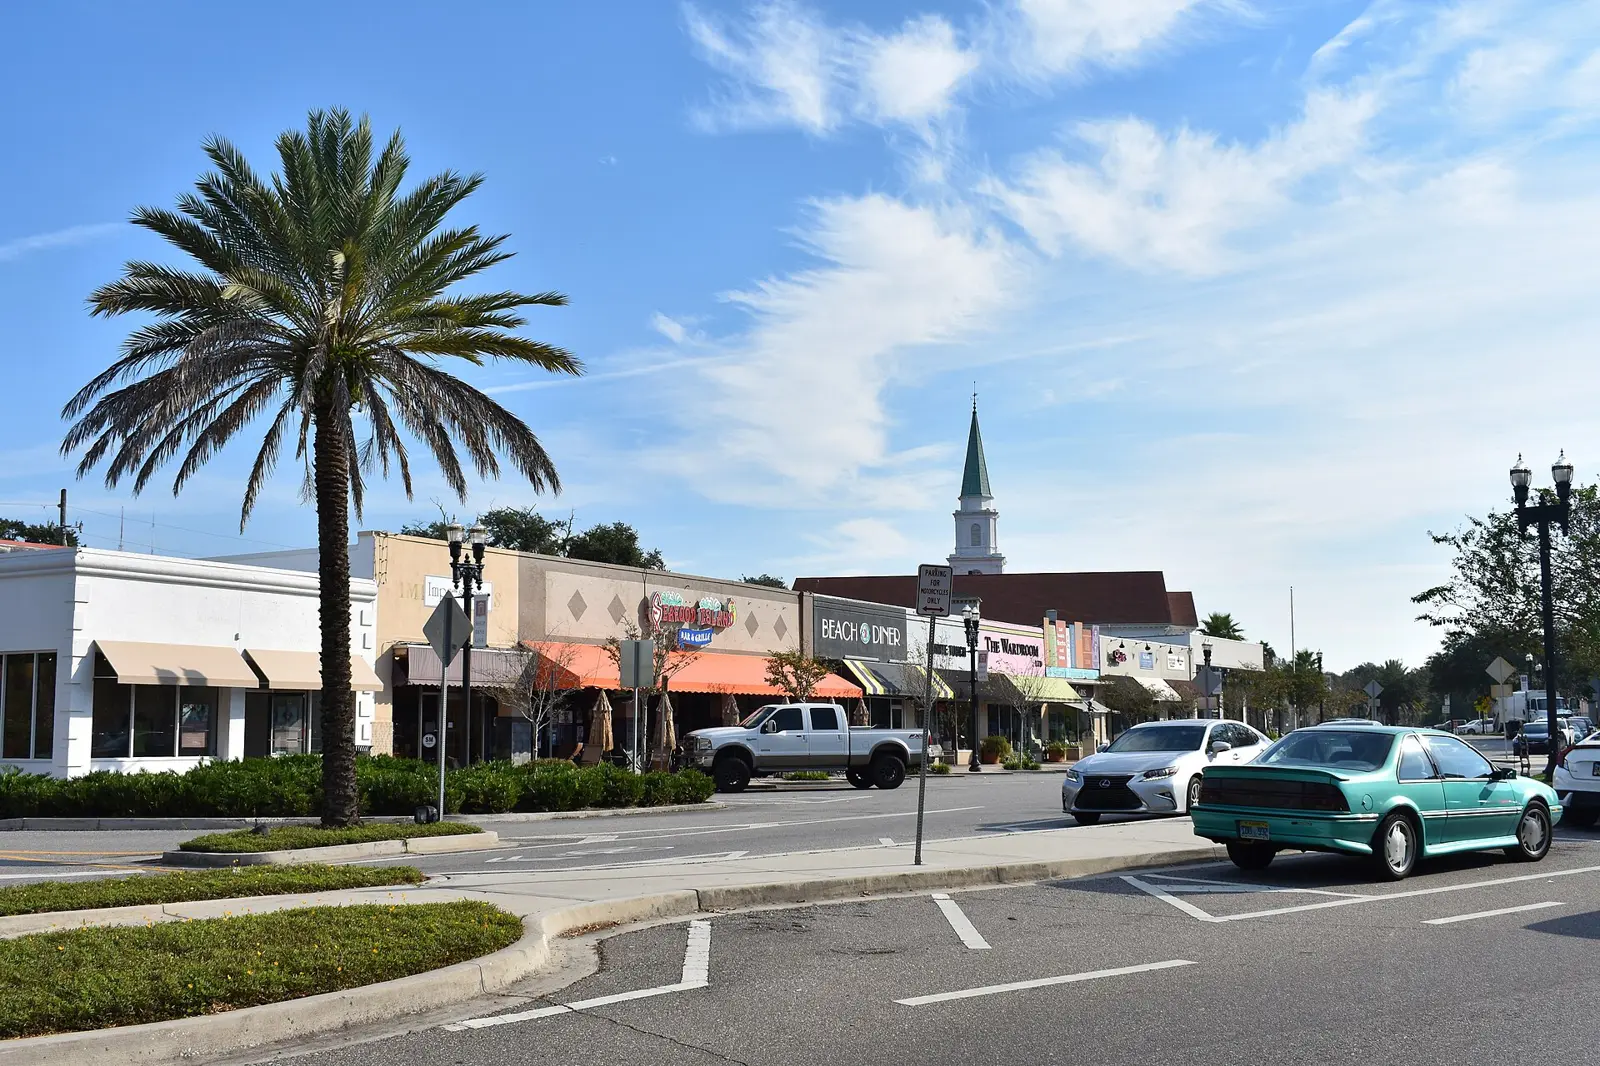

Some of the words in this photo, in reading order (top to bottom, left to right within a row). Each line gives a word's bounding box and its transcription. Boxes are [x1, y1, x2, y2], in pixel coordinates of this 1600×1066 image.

[925, 569, 947, 578] PARKING
[930, 579, 941, 587] FOR
[920, 587, 949, 596] MOTORCYCLES
[926, 596, 941, 605] ONLY
[652, 591, 697, 633] SEAFOOD
[699, 607, 735, 628] ISLAND
[680, 630, 691, 641] BAR
[821, 618, 858, 642] BEACH
[872, 624, 901, 646] DINER
